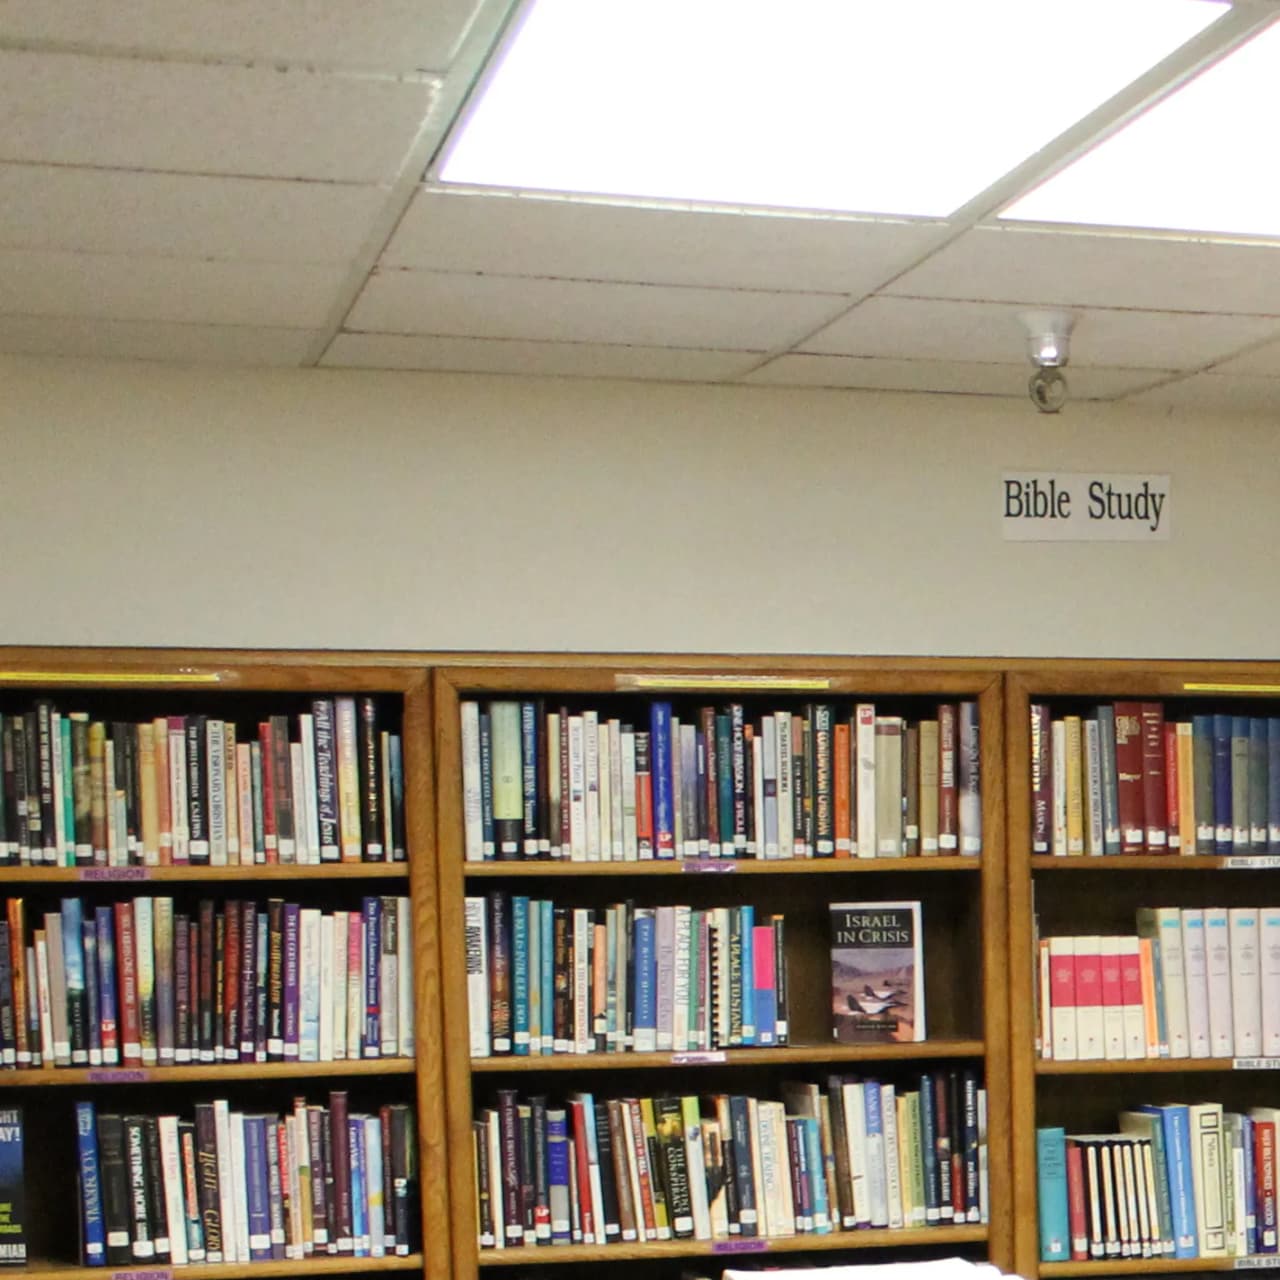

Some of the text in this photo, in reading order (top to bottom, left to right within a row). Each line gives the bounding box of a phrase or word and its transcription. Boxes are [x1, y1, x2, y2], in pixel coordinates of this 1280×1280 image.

[1003, 478, 1167, 532] Bible Study
[317, 714, 338, 845] All the Teachings Jesus
[84, 869, 145, 880] RELIGION
[838, 928, 909, 944] IN CRISIS
[845, 913, 901, 928] ISRAEL
[676, 920, 690, 1006] PLACE FOR YOU
[128, 1127, 146, 1219] SOMETHING MORE
[199, 1152, 218, 1189] LIGHT
[666, 1147, 680, 1215] CONSPIRACY
[675, 1147, 689, 1211] THE DIVINE
[203, 1210, 219, 1250] GLORY
